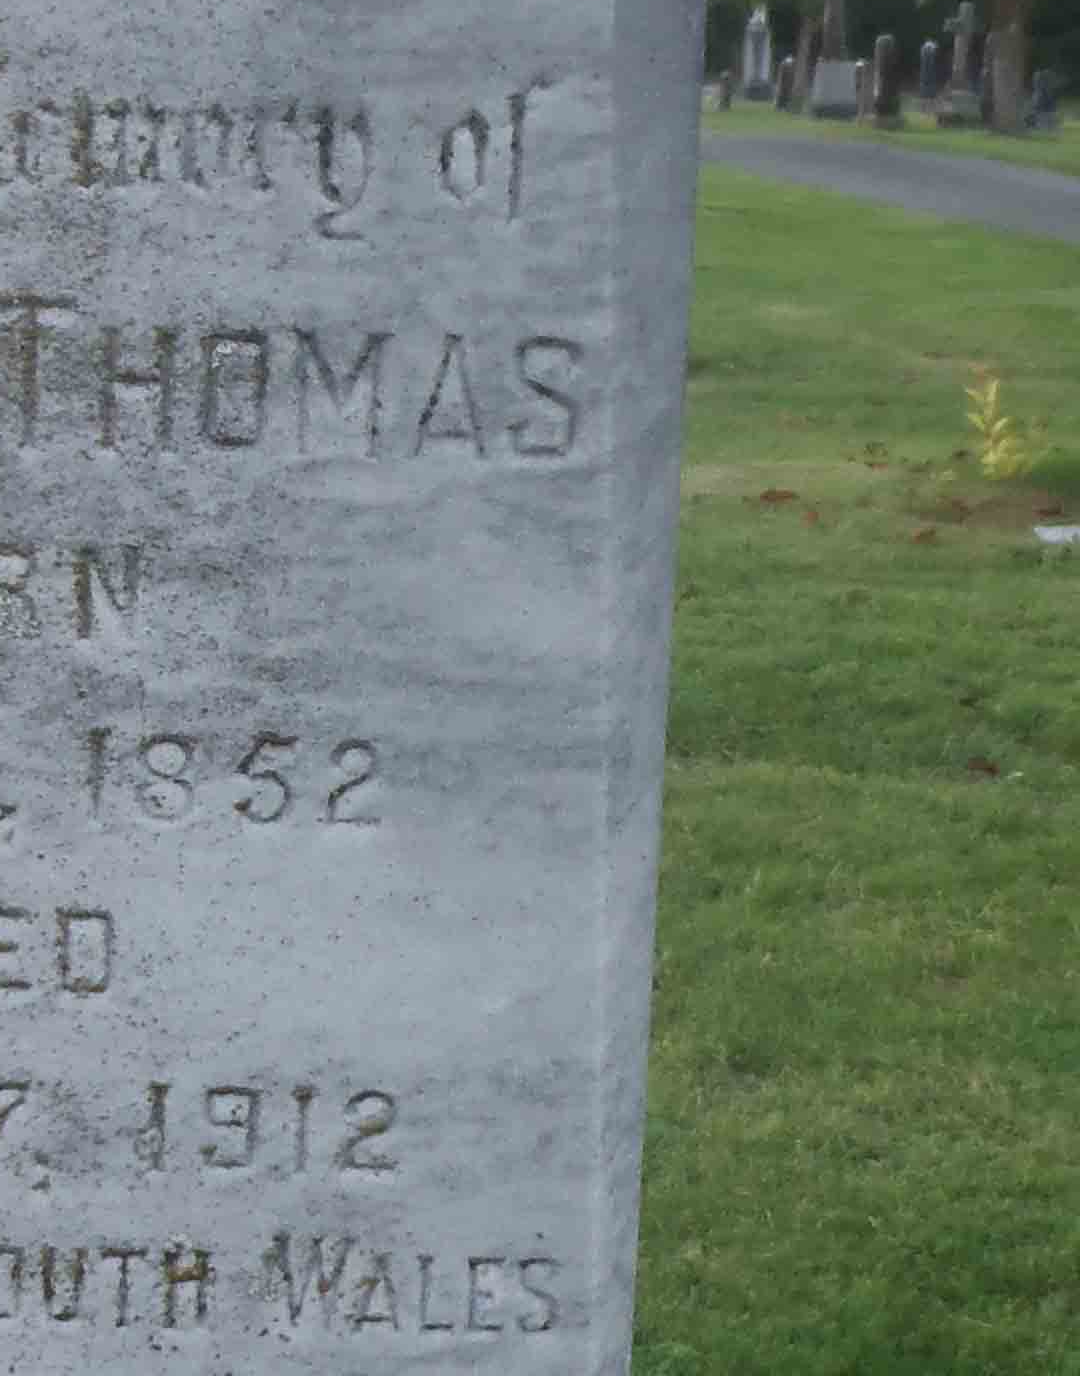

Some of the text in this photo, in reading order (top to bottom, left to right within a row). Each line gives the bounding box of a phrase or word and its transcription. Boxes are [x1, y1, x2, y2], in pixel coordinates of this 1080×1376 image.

[436, 72, 560, 224] of
[86, 724, 383, 827] 1852
[135, 1080, 402, 1174] 1912
[260, 1230, 564, 1334] WALES
